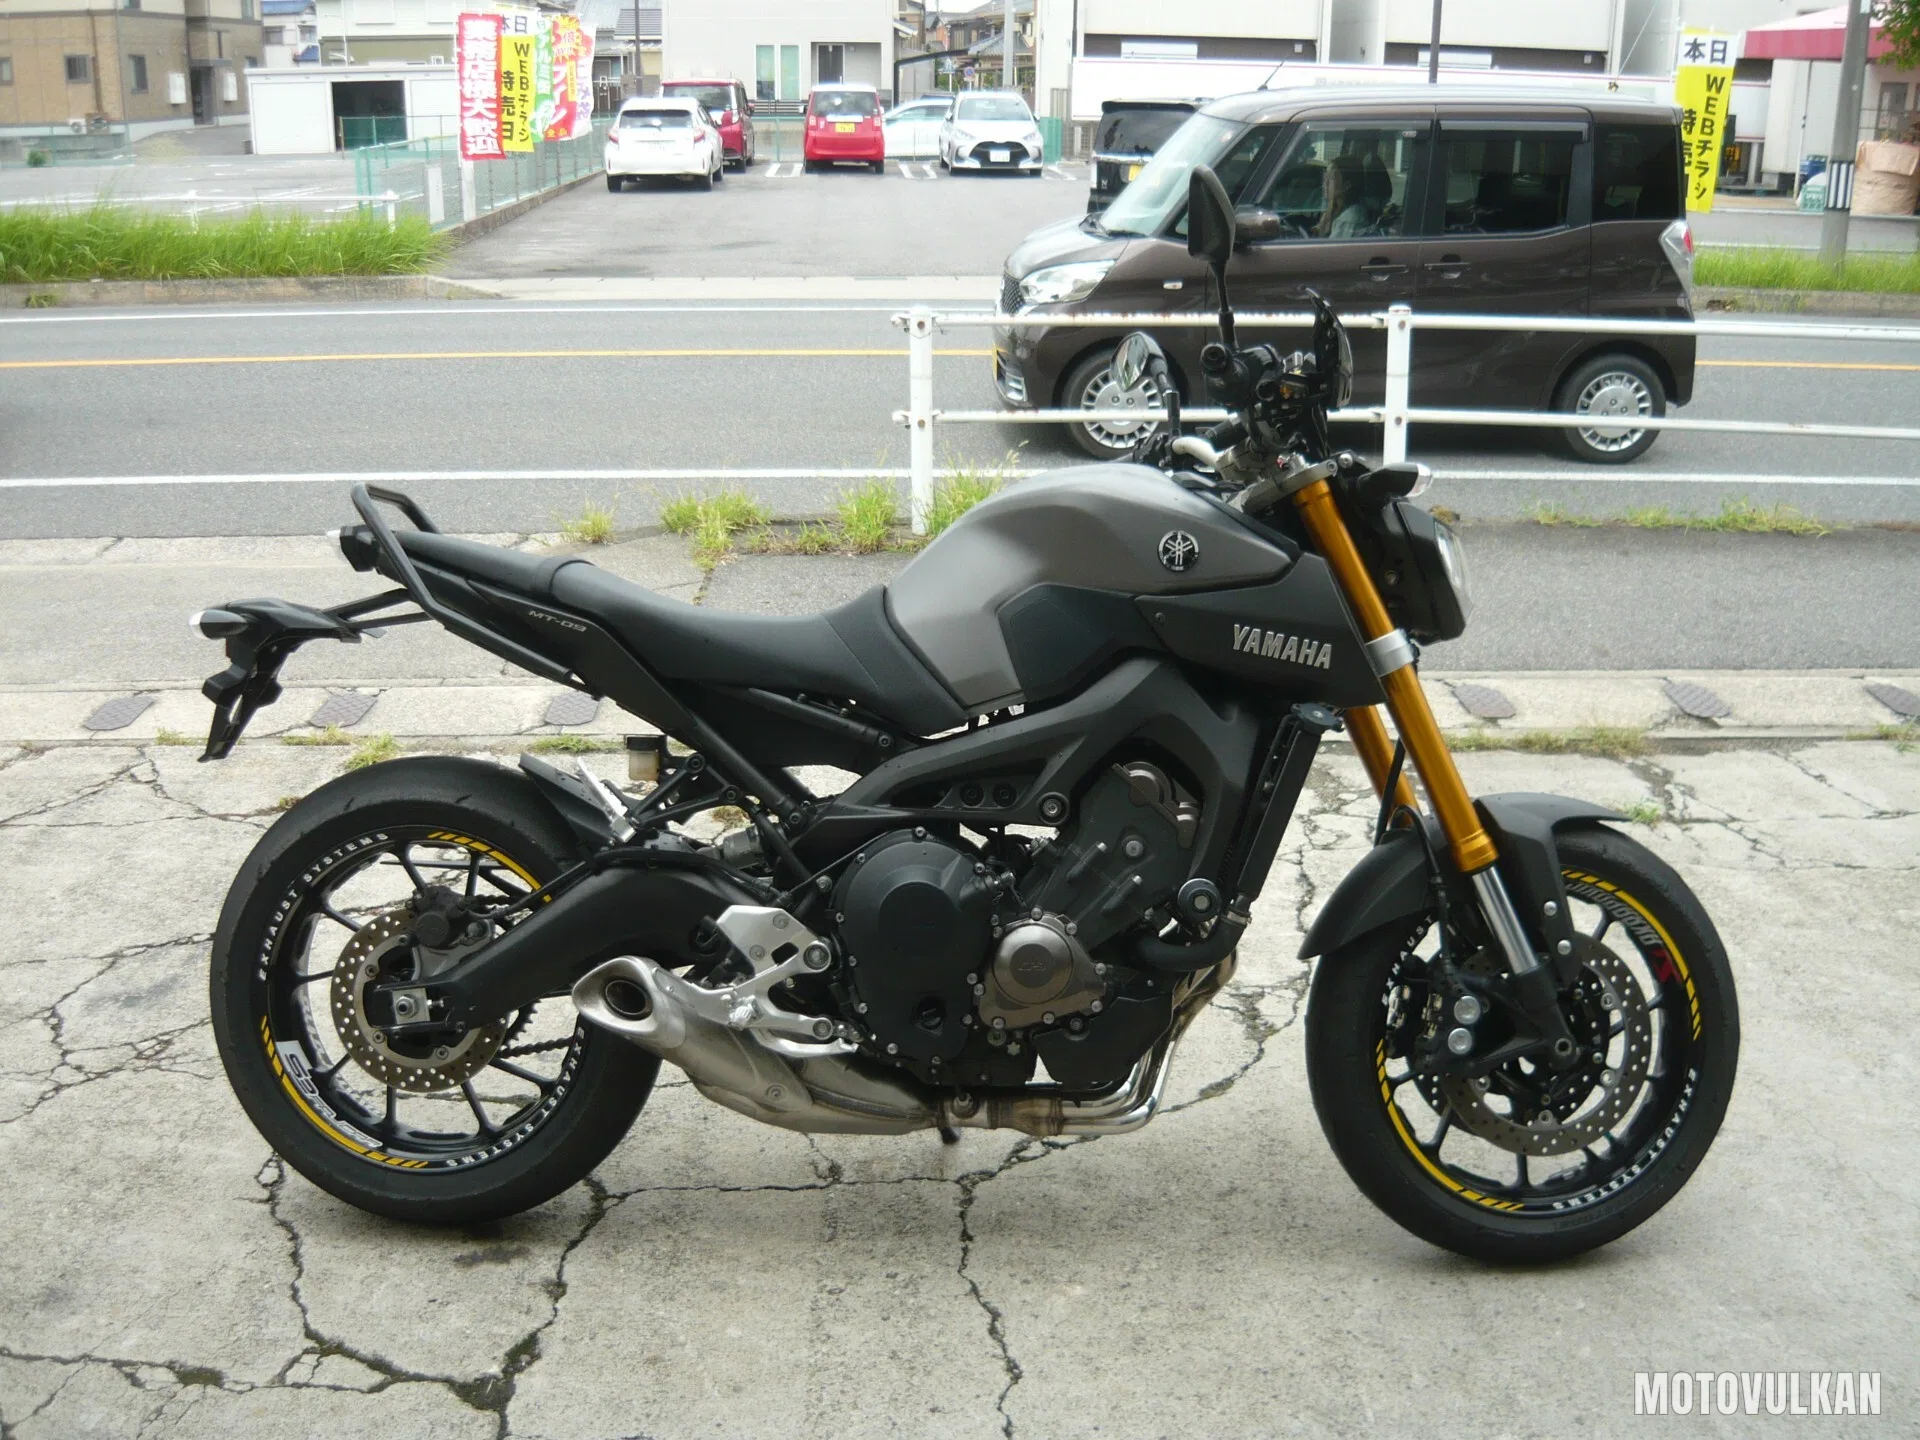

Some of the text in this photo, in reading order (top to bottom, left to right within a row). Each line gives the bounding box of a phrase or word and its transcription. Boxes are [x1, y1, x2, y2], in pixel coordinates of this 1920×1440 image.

[1684, 37, 1728, 64] 本日
[1694, 74, 1726, 200] WEBチラシ
[528, 611, 587, 632] MT-09
[1233, 624, 1332, 669] YAMAHA
[258, 833, 388, 981] EXHAUST SYSTEMS
[1381, 915, 1432, 1006] EXHAUST
[446, 1027, 585, 1167] EXHAUST SYSTEMS
[1552, 1068, 1697, 1210] EXHAUST SYSTEMS
